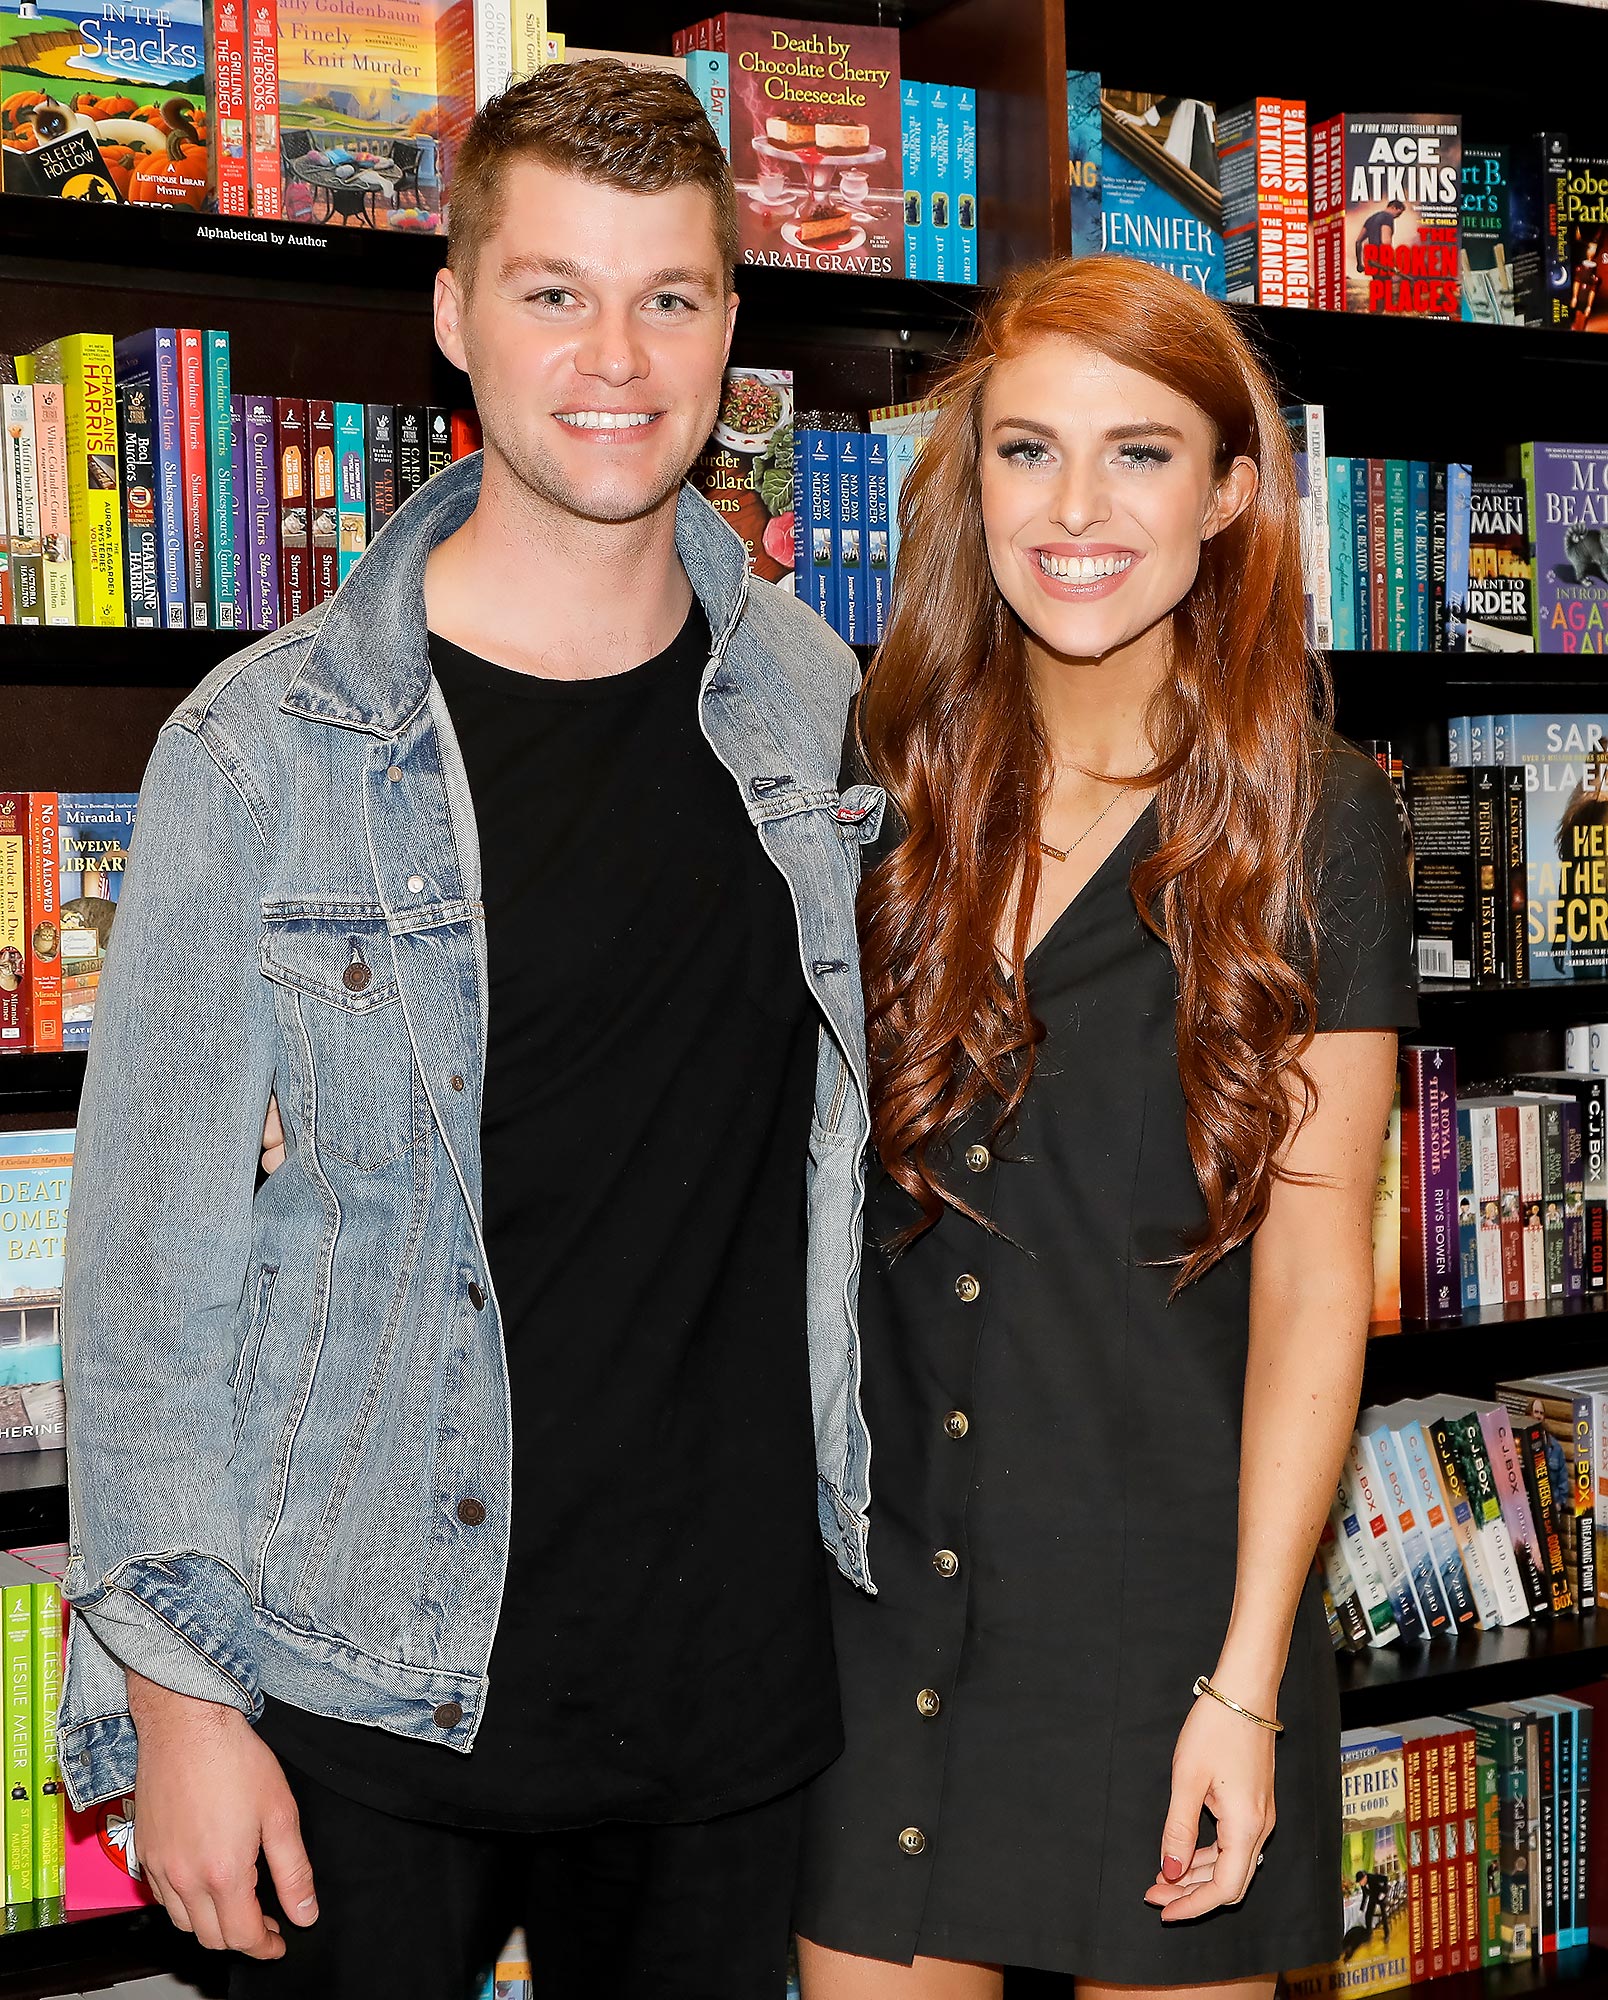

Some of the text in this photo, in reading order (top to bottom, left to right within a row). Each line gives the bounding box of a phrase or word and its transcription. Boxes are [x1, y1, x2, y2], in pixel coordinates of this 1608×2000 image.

[102, 3, 172, 28] IN THE
[79, 19, 197, 69] Stacks
[302, 47, 422, 77] Knit Murder
[770, 30, 851, 62] Death by
[217, 39, 231, 117] THE SUBJECT
[230, 51, 243, 106] GRILLING
[253, 39, 265, 112] THE BOOKS
[264, 46, 276, 105] FUDGING
[738, 51, 891, 89] Chocolate Cherry
[764, 75, 866, 107] Cheesecake
[1259, 104, 1281, 115] ACE
[1283, 108, 1305, 119] ACE
[1350, 123, 1458, 136] NEW YORK TIMES BESTSELLING AUTHOR
[1259, 114, 1283, 189] ATKINS
[1283, 119, 1307, 193] ATKINS
[1314, 130, 1327, 142] ACE
[1368, 137, 1440, 165] ACE
[1314, 142, 1328, 214] ATKINS
[1331, 135, 1343, 207] ATKINS
[1351, 165, 1458, 204] ATKINS
[196, 226, 328, 248] Alphabetical by Author
[1101, 211, 1216, 257] JENNIFER
[1261, 217, 1282, 227] THE
[1286, 221, 1307, 231] THE
[1417, 227, 1457, 243] THE
[743, 249, 893, 273] SARAH GRAVES
[1261, 228, 1284, 308] RANGER
[1286, 232, 1309, 308] RANGER
[1363, 243, 1458, 277] BROKEN
[1368, 279, 1459, 314] PLACES
[83, 363, 103, 451] HARRIS
[101, 363, 116, 452] CHARLAINE
[125, 431, 139, 482] Murders
[138, 437, 153, 465] Real
[401, 447, 411, 482] HART
[253, 432, 271, 546] Charlaine Harris
[375, 481, 385, 513] HART
[812, 471, 822, 521] MURDER
[822, 473, 831, 520] MAY DAY
[841, 473, 850, 523] MURDER
[850, 474, 859, 521] MAY DAY
[868, 474, 878, 524] MURDER
[878, 476, 887, 523] MAY DAY
[1470, 495, 1523, 512] GARET
[191, 473, 205, 589] Shakespeare's Christmas
[1471, 512, 1524, 535] MAN
[97, 524, 106, 573] MYSTERIES
[104, 501, 115, 596] AURORA TEAGARDEN
[1393, 528, 1405, 566] BEATON
[1416, 535, 1428, 581] BEATON
[1433, 536, 1445, 582] BEATON
[21, 565, 29, 608] HAMILTON
[28, 567, 36, 606] VICTORIA
[130, 550, 143, 601] HARRIS
[141, 531, 156, 610] CHARLAINE
[320, 554, 332, 588] Sherry
[66, 810, 122, 823] Miranda
[1479, 800, 1491, 858] PERISH
[1510, 797, 1520, 868] LISA BLACK
[62, 837, 121, 852] TWELVE
[6, 841, 19, 943] Murder Past Due
[1482, 896, 1492, 975] LISA BLACK
[1515, 914, 1523, 979] UNPUNISHED
[2, 998, 10, 1021] James
[10, 993, 18, 1026] Miranda
[34, 991, 61, 999] Miranda
[38, 998, 57, 1007] James
[1429, 1076, 1441, 1175] THREESOME
[1441, 1090, 1451, 1159] A ROYAL
[1503, 1132, 1511, 1169] BOWEN
[1549, 1147, 1557, 1185] BOWEN
[1434, 1189, 1446, 1275] RHYS BOWEN
[1591, 1207, 1603, 1273] STONE COLD
[1534, 1449, 1548, 1478] THREE
[1538, 1475, 1552, 1507] WEEKS
[1543, 1507, 1549, 1519] TO
[1493, 1525, 1518, 1605] COLD WIND
[1547, 1533, 1565, 1576] GOODBYE
[1580, 1517, 1595, 1593] BREAKING POINT
[1345, 1597, 1363, 1630] SIGHT
[1553, 1595, 1573, 1612] BOX
[13, 1655, 28, 1706] LESLIE
[43, 1651, 58, 1701] LESLIE
[13, 1715, 29, 1768] MEIER
[44, 1710, 58, 1763] MEIER
[1344, 1746, 1377, 1760] MYSTERY
[1344, 1767, 1399, 1798] FFRIES
[1431, 1748, 1439, 1817] MRS. JEFFRIES
[1449, 1771, 1457, 1814] JEFFRIES
[21, 1807, 30, 1890] ST PATRICK'S DAY
[42, 1827, 51, 1866] MURDER
[1562, 1799, 1570, 1855] ALAFAIR
[1580, 1798, 1588, 1854] ALAFAIR
[11, 1833, 20, 1870] MURDER
[1545, 1866, 1553, 1907] BURKE
[1466, 1887, 1475, 1940] BRIGHTWELL
[1328, 1957, 1407, 1991] BRIGHTWELL
